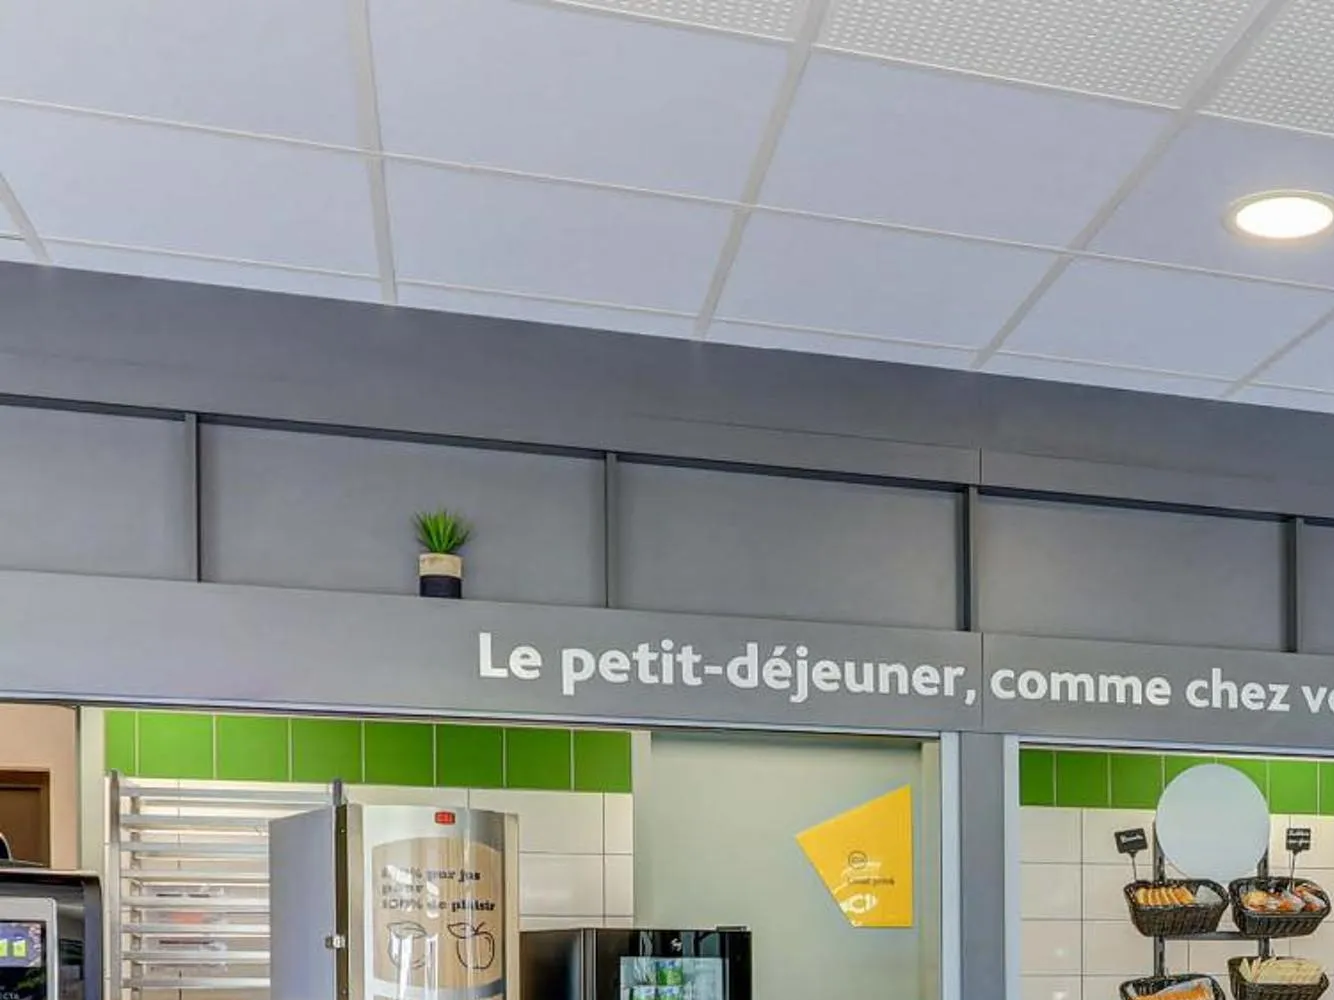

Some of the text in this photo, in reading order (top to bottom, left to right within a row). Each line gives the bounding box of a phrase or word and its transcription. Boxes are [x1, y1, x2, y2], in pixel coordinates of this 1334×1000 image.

[479, 632, 541, 679] Le
[561, 639, 977, 705] petit-déjeuner,
[989, 667, 1171, 706] comme
[1185, 667, 1290, 712] chez
